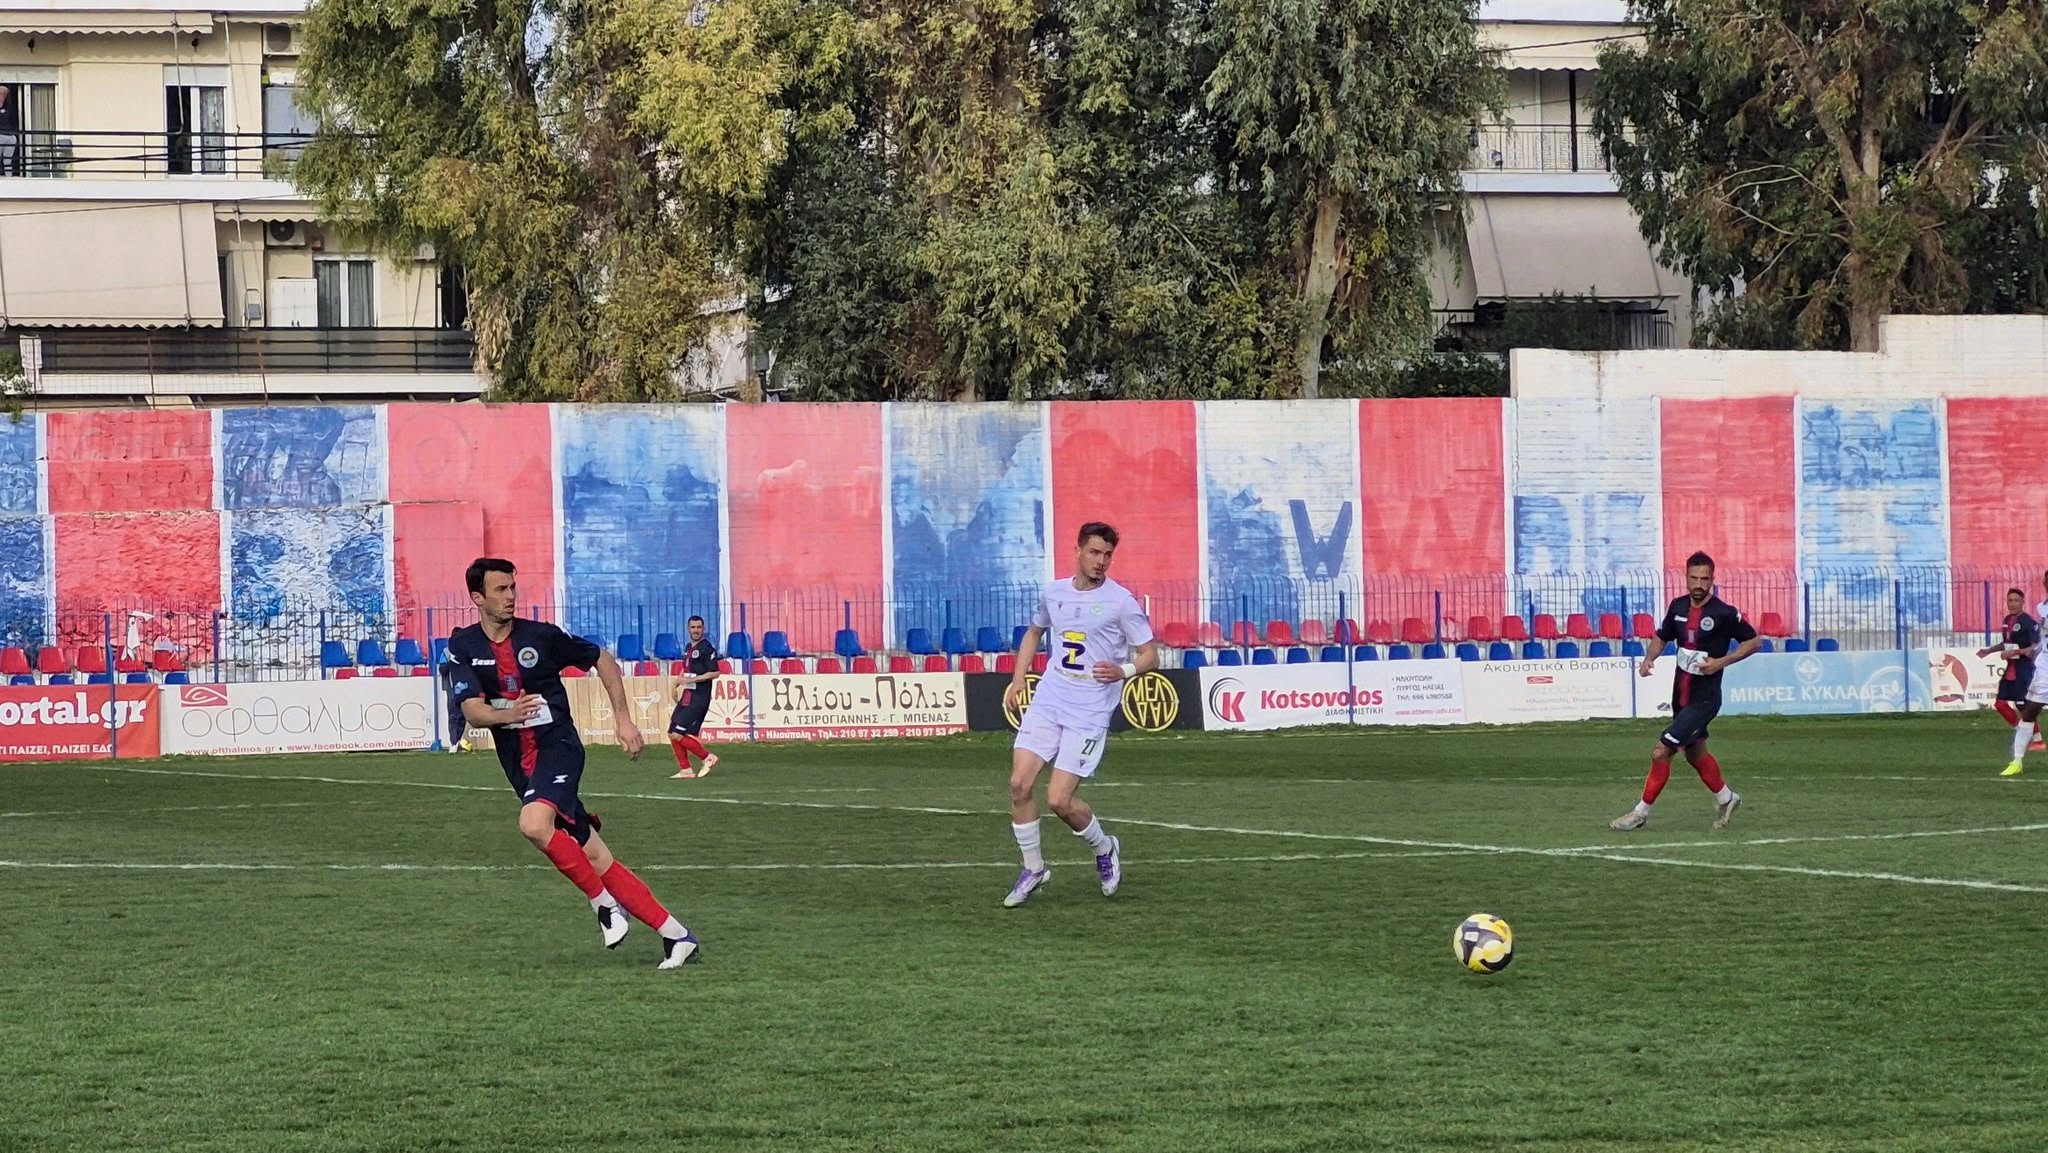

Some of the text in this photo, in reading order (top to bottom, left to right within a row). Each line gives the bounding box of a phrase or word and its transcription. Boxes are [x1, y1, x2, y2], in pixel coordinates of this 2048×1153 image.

[1483, 660, 1564, 673] Ακουστικά
[715, 680, 749, 700] ΑΒΑ
[1731, 683, 1890, 703] ΜΙΚΡΕΣ ΚΥΚΛΑΔΕΣ
[1261, 685, 1383, 710] Kotsovolos
[797, 713, 879, 725] ΤΣΙΡΟΓΙΑΝΝΗΣ
[903, 712, 950, 723] ΜΠΕΝΑΣ
[840, 728, 857, 738] 210
[858, 727, 869, 738] 97
[905, 727, 922, 737] 210
[9, 745, 51, 756] ΠΑΙΖΕΙ,
[53, 744, 90, 754] ΠΑΙΖΕΙ
[287, 739, 431, 751] www.facebook.com/ofthalmo
[1081, 738, 1097, 756] 27
